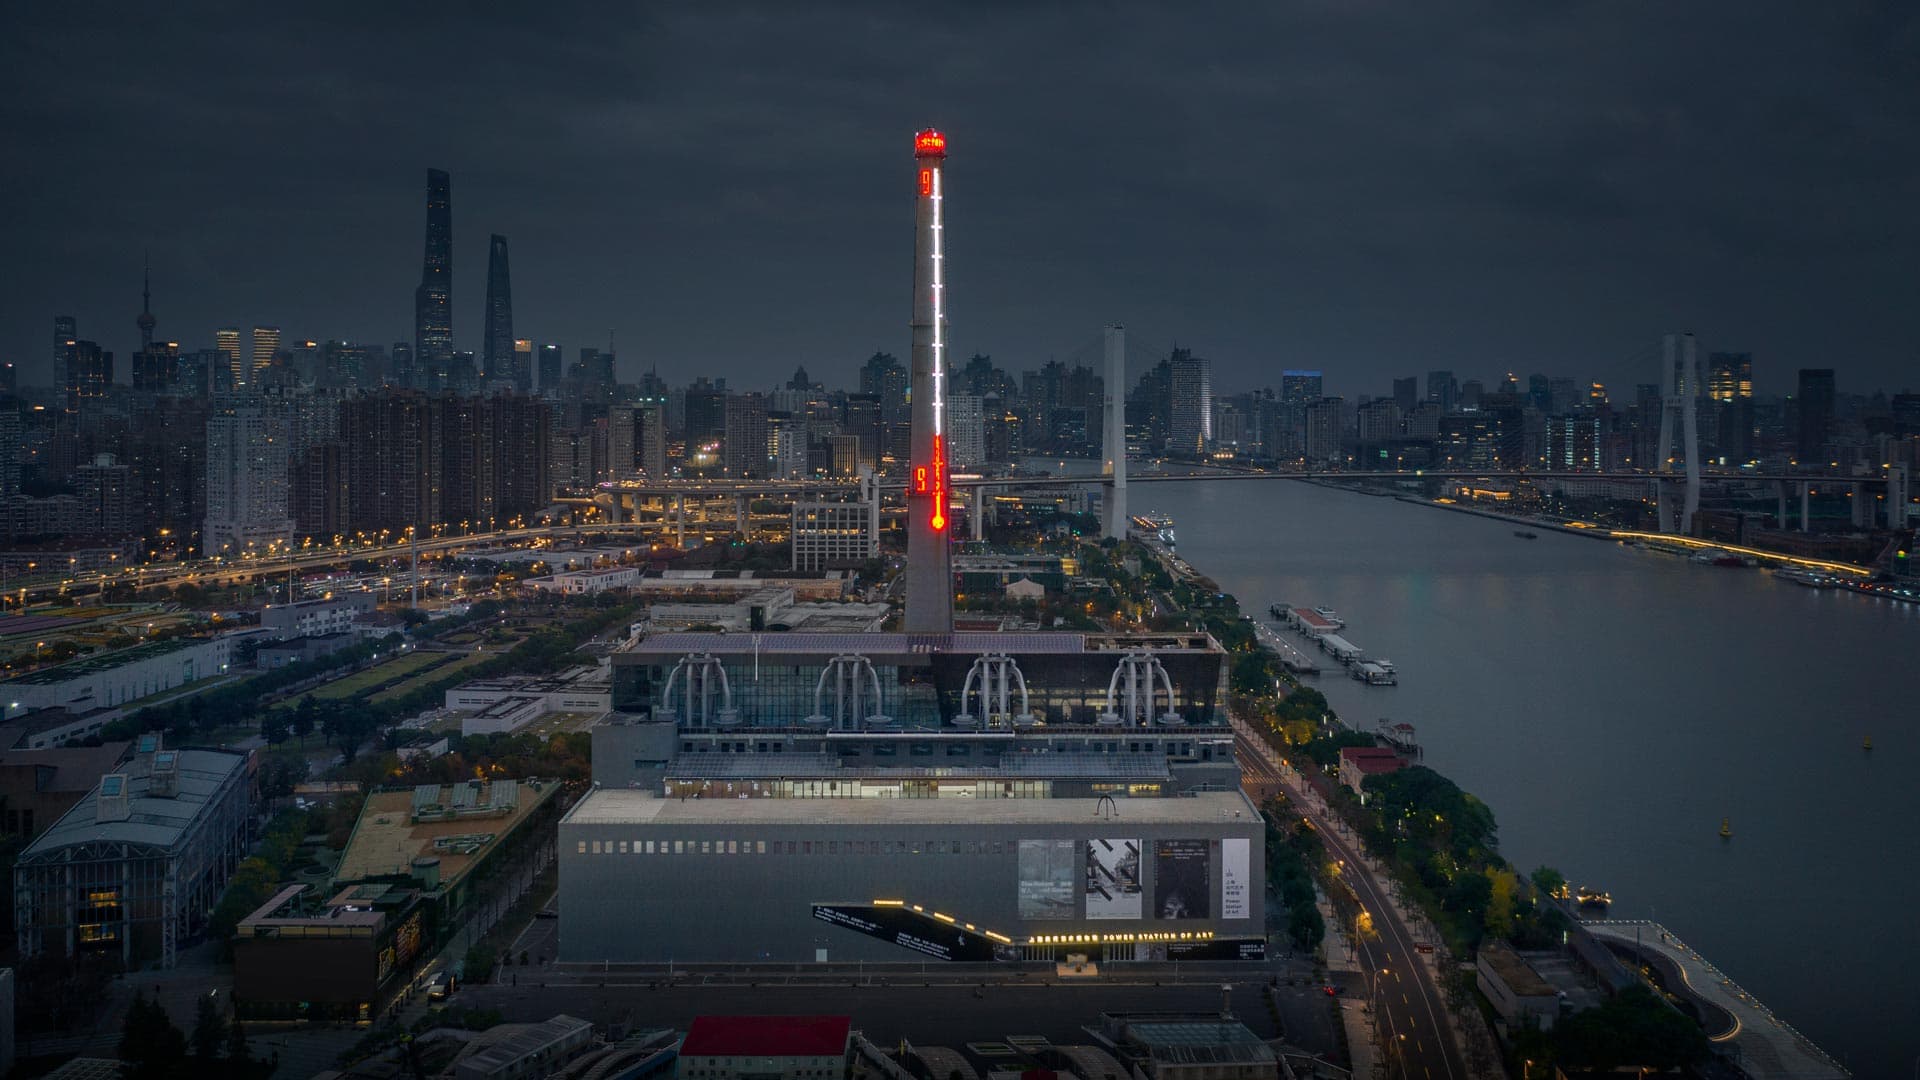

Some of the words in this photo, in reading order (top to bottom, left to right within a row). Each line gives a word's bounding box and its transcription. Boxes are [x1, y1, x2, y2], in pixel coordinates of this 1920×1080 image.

[922, 171, 930, 194] 9
[917, 467, 926, 491] 9
[1103, 933, 1134, 941] POWER
[1138, 932, 1177, 940] STATION
[1180, 931, 1192, 939] OF
[1195, 931, 1214, 939] ART
